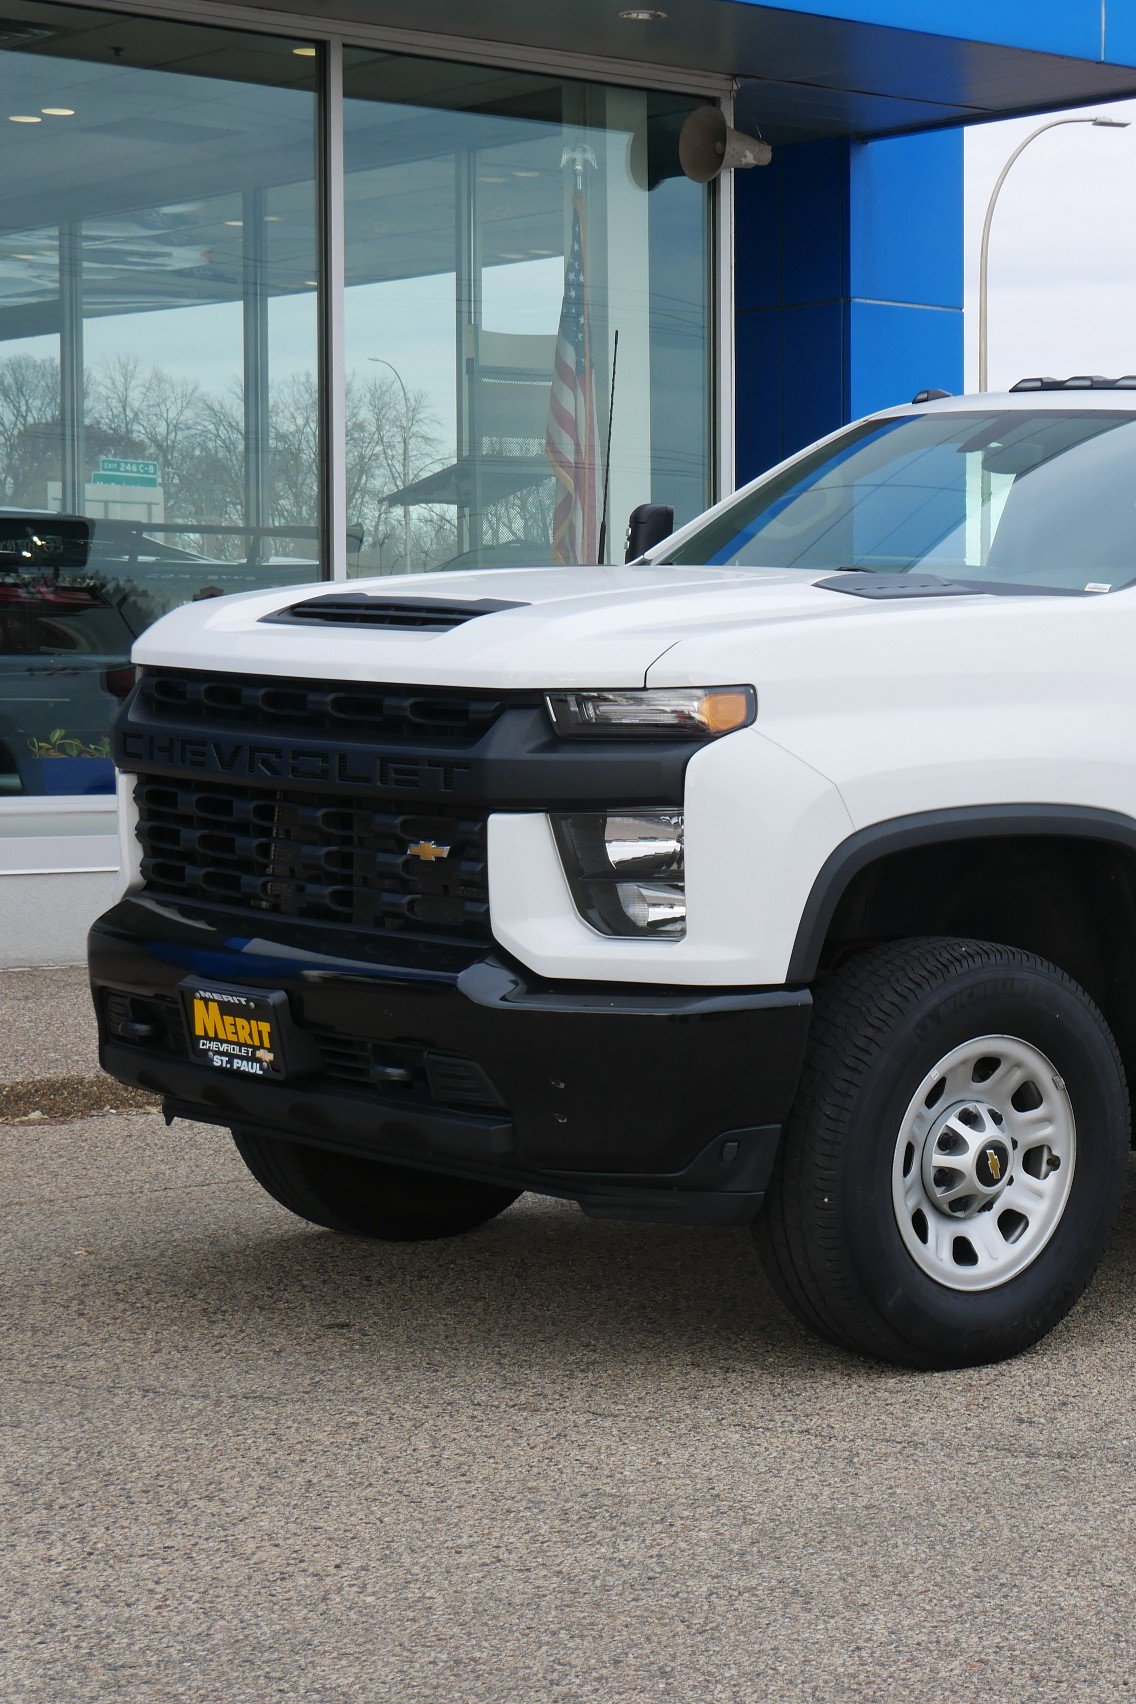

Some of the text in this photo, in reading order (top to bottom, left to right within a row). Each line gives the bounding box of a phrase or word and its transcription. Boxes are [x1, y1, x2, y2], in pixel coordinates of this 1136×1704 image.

[120, 463, 137, 471] 246
[122, 732, 471, 792] CHEVROLET
[199, 990, 247, 1005] MERIT
[199, 1040, 253, 1057] CHEVROLET
[213, 1055, 264, 1075] ST. PAUL
